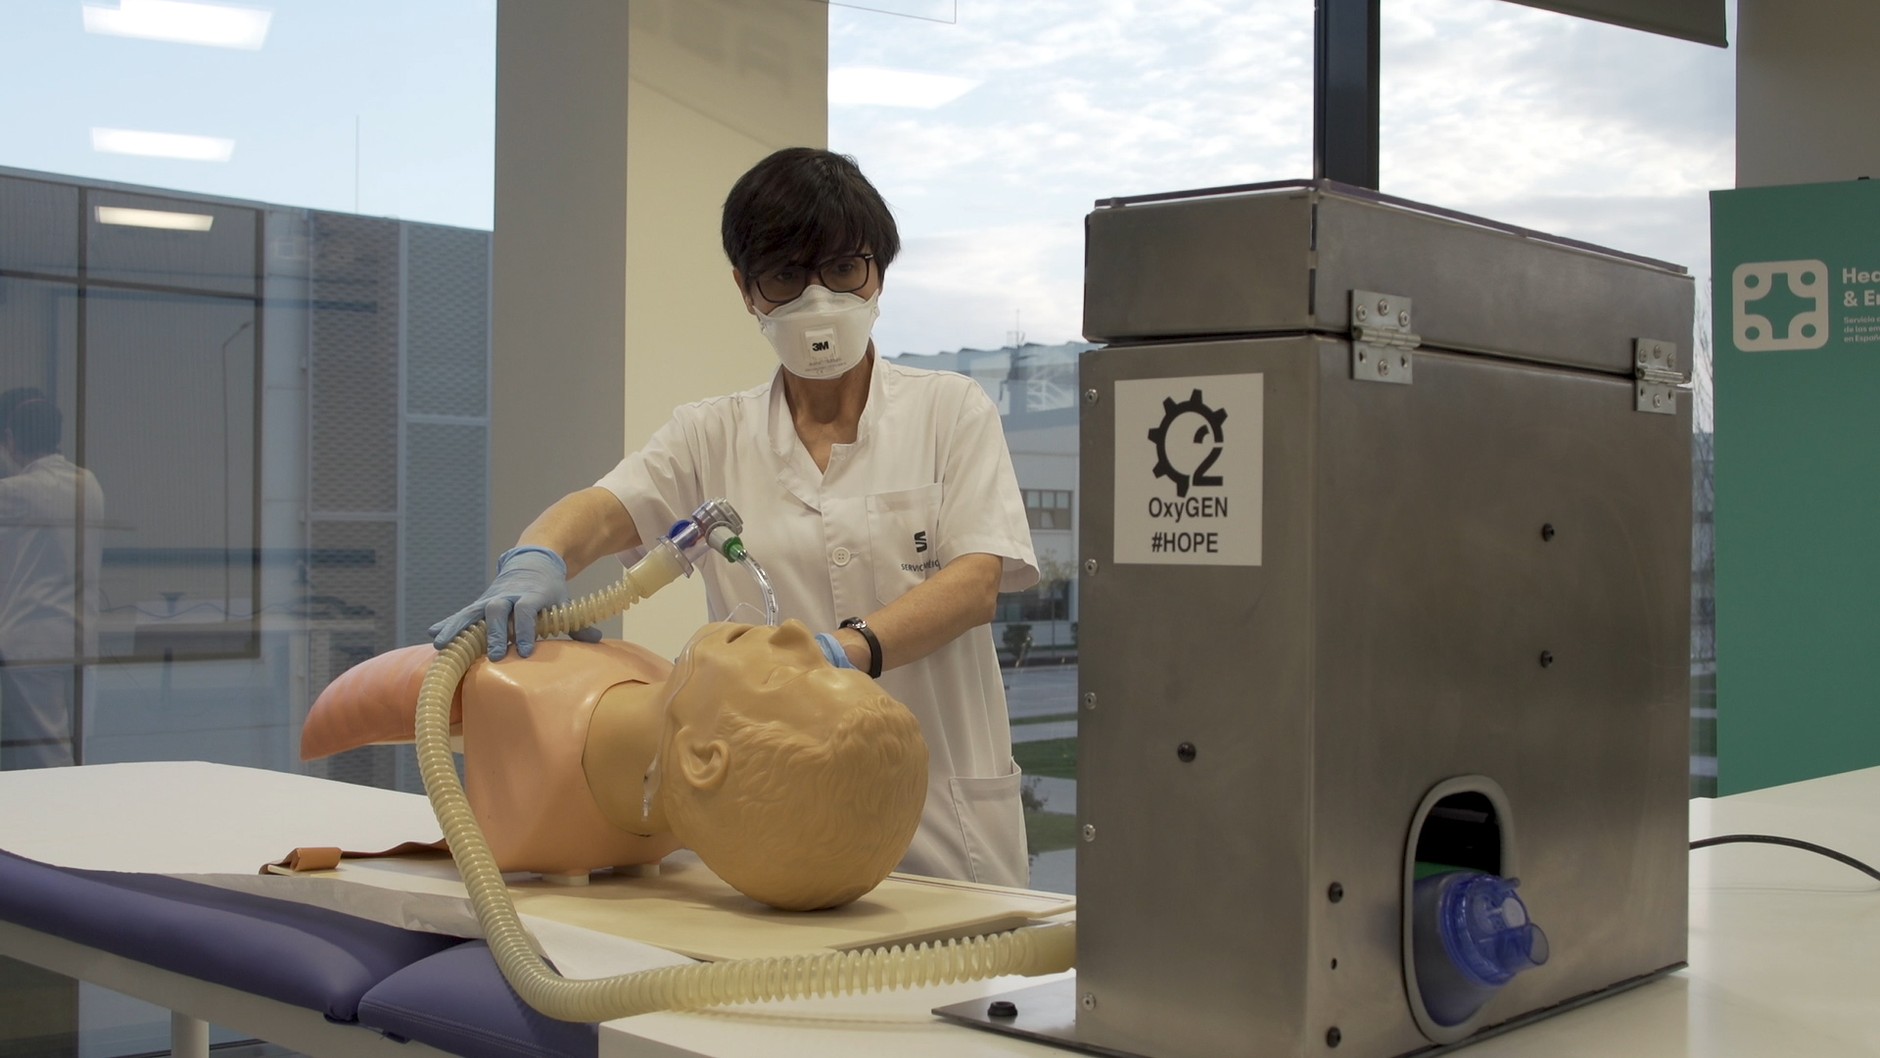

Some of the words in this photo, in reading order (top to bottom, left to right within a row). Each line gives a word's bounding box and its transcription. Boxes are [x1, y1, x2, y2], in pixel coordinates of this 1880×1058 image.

[1843, 290, 1857, 307] &
[812, 341, 829, 351] 3M
[1148, 497, 1228, 523] OxyGEN
[1151, 532, 1219, 553] #HOPE
